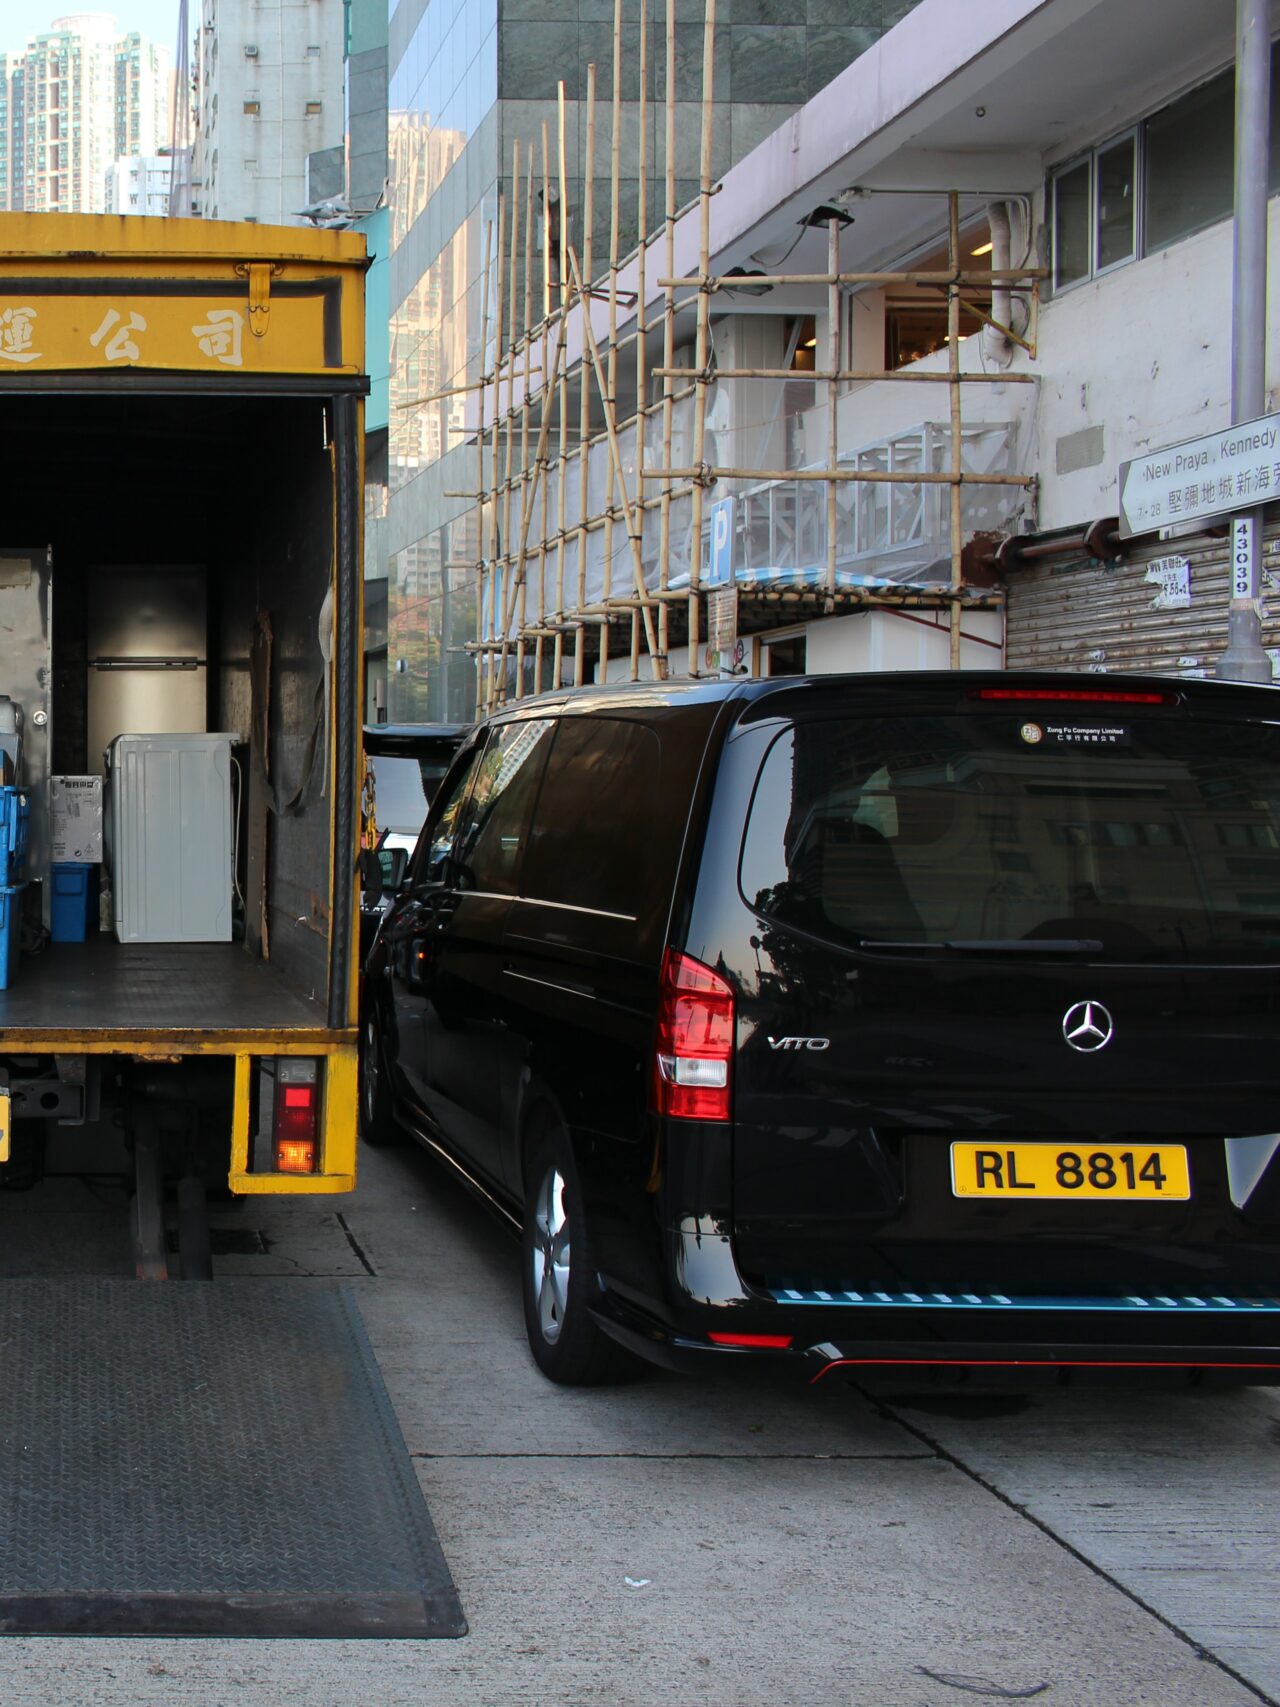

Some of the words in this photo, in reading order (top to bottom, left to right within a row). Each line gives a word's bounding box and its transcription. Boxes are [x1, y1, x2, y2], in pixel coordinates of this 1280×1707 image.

[1145, 462, 1171, 482] New
[1220, 427, 1277, 460] Kennedy
[713, 509, 728, 577] P
[1236, 524, 1248, 593] 43039
[1047, 726, 1063, 734] Zung
[1072, 727, 1101, 735] Company
[767, 1036, 830, 1051] VITO
[975, 1150, 1036, 1189] RL
[1055, 1151, 1167, 1191] 8814
